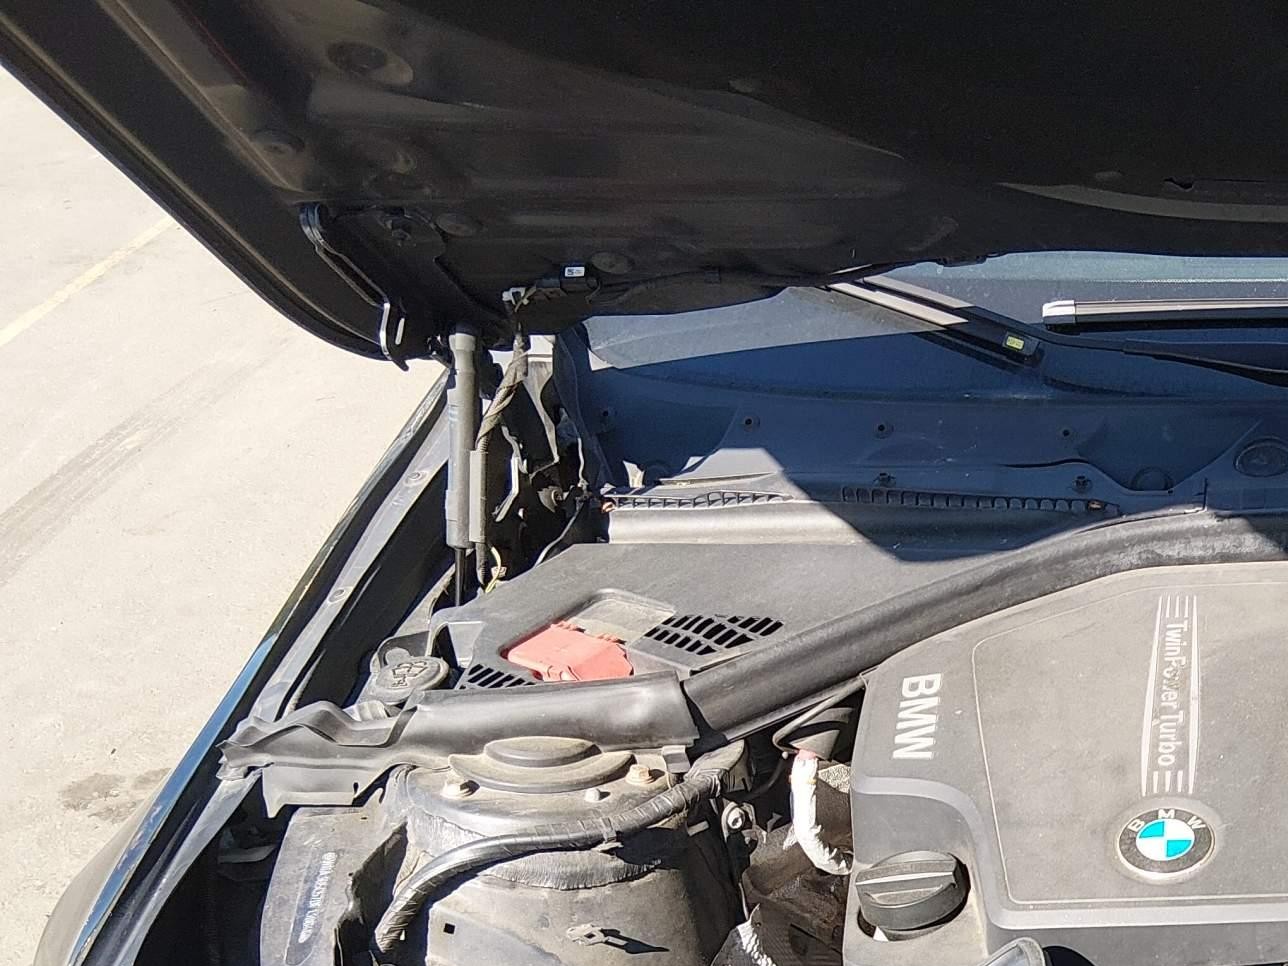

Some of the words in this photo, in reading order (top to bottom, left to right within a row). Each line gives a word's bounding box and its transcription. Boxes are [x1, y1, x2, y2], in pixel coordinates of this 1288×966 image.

[892, 673, 942, 760] BMW
[1157, 710, 1184, 767] Turbo
[1127, 809, 1206, 832] BMW
